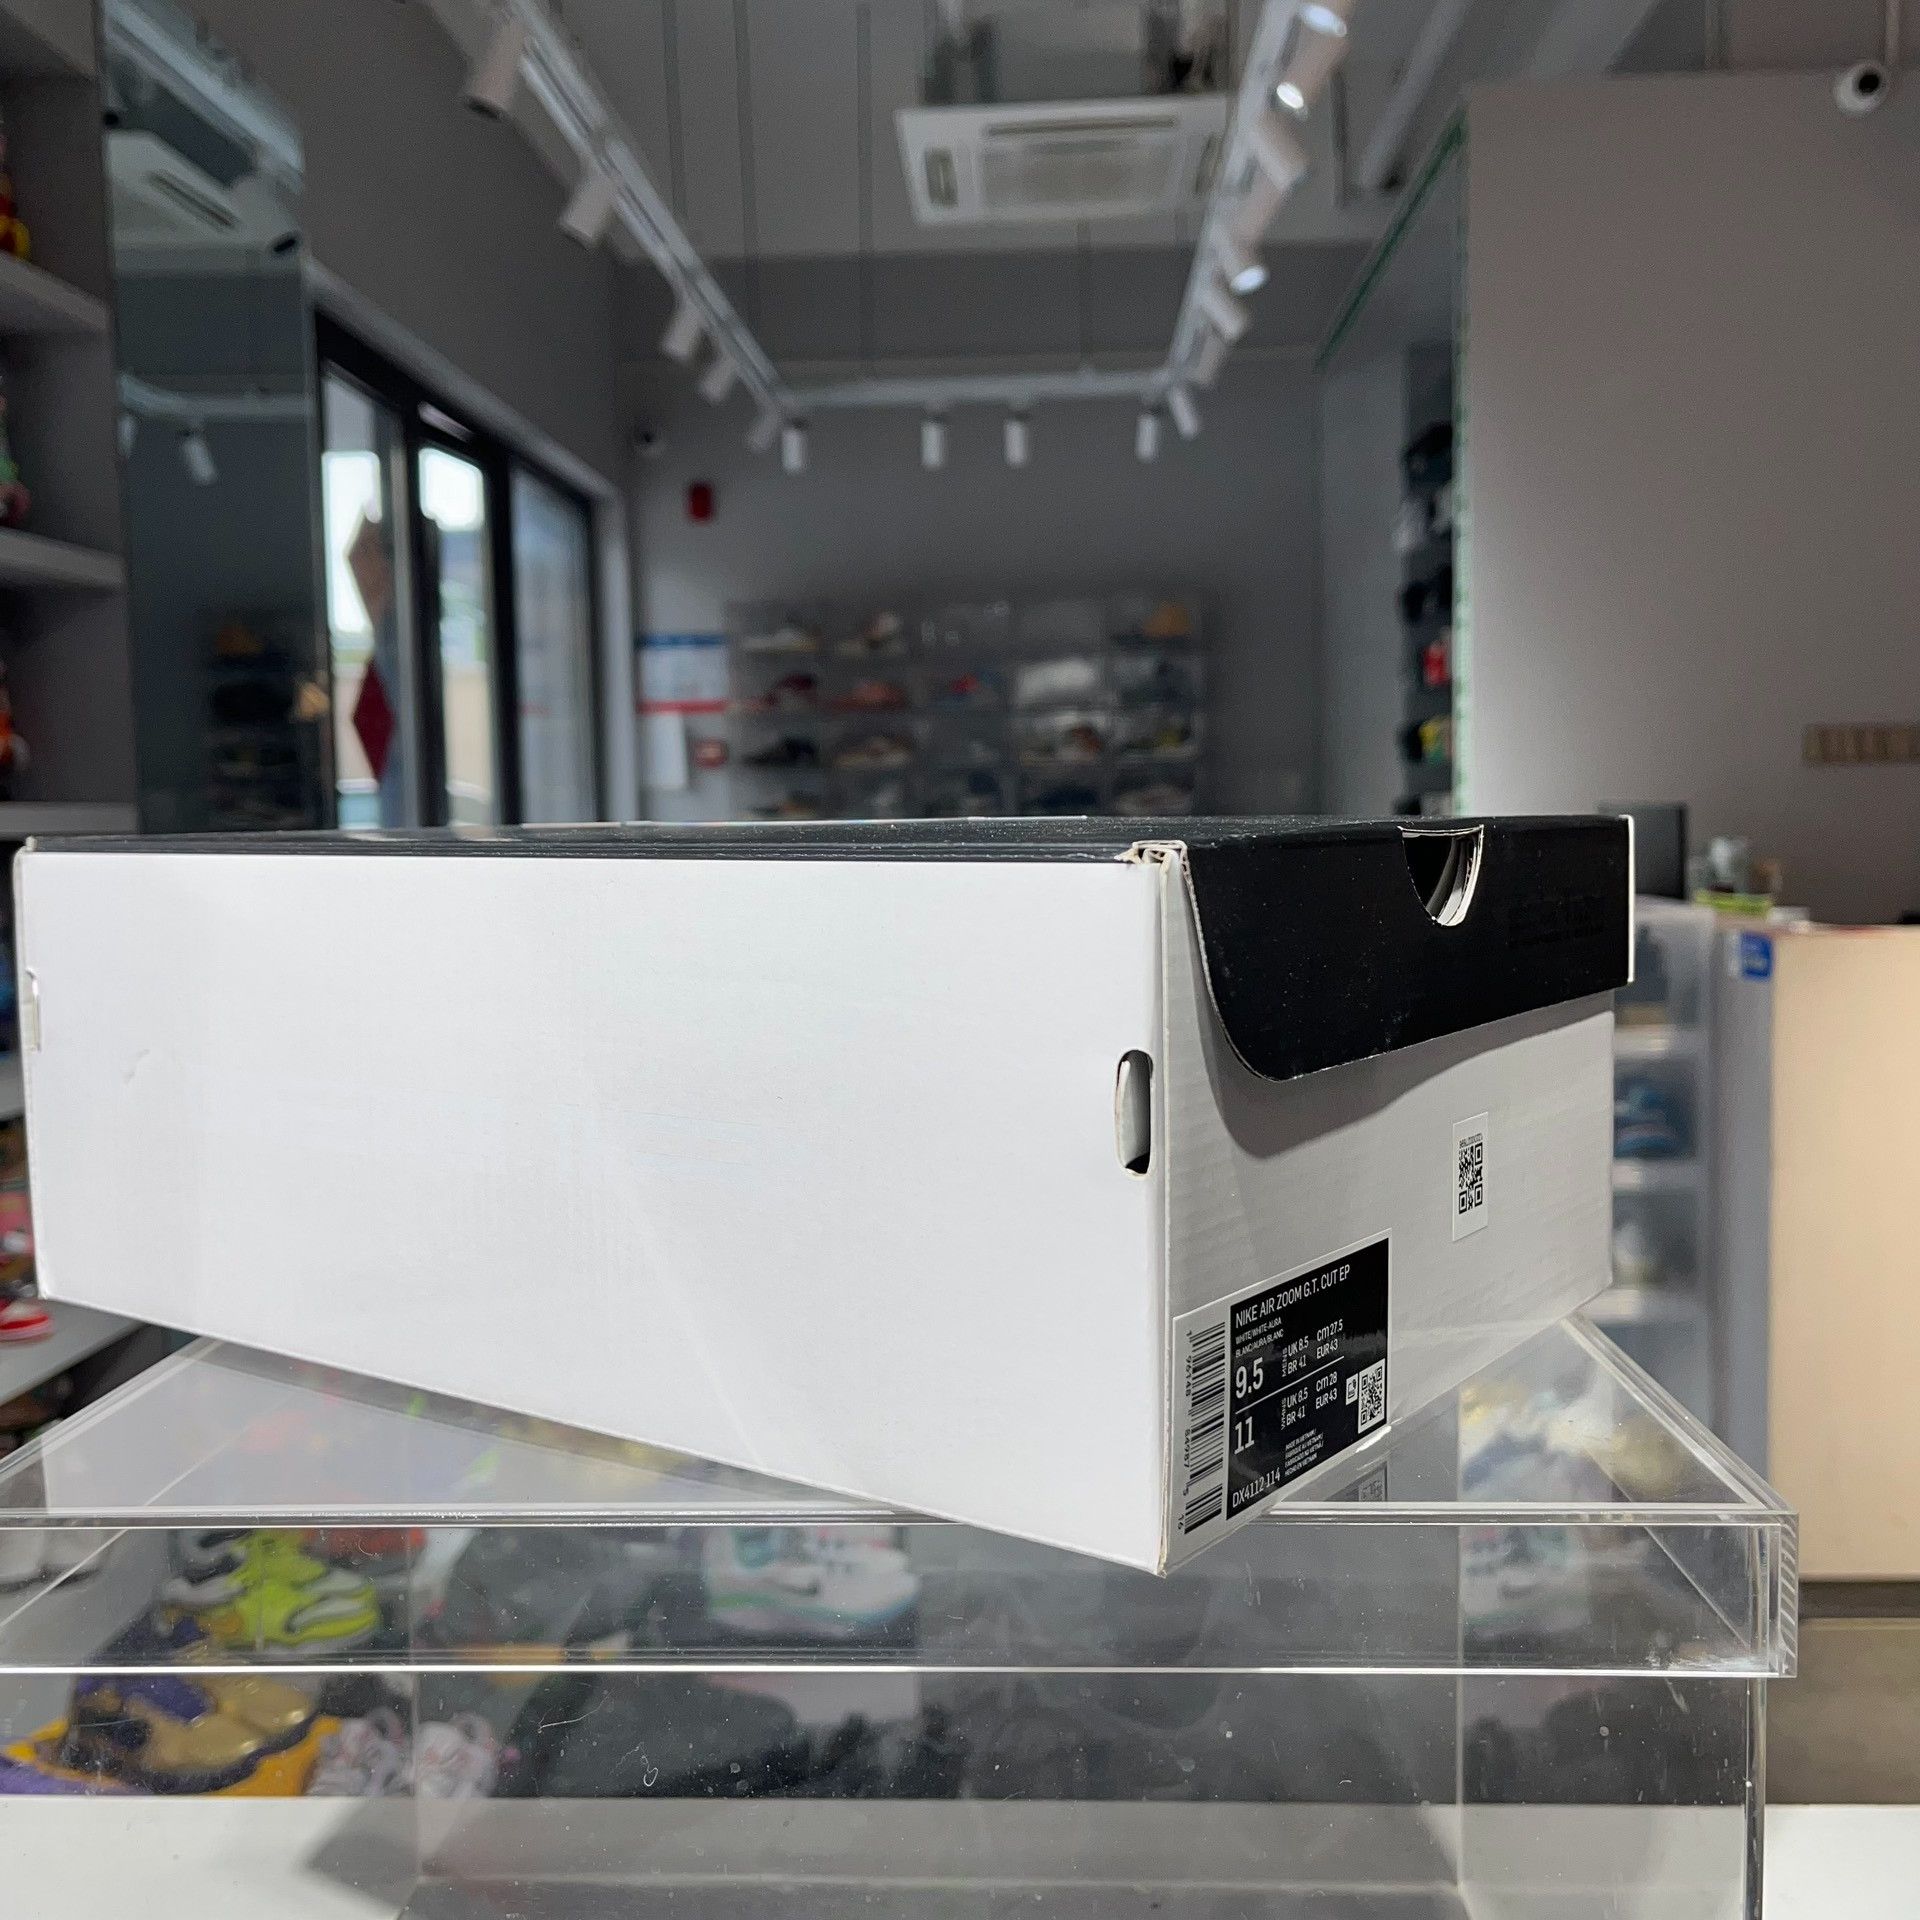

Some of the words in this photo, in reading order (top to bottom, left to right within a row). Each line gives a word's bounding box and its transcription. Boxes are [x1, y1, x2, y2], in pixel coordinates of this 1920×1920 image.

[1236, 1305, 1257, 1328] NIKE
[1260, 1298, 1274, 1317] AIR
[1277, 1286, 1302, 1310] ZOOM
[1304, 1278, 1319, 1297] G.T.
[1321, 1269, 1338, 1289] CUT
[1340, 1264, 1350, 1281] EP
[1331, 1319, 1343, 1335] 27.5
[1288, 1342, 1298, 1356] UK
[1299, 1336, 1309, 1351] 8.5
[1317, 1344, 1329, 1359] EUR
[1329, 1339, 1338, 1352] 43
[1288, 1360, 1297, 1374] BR
[1299, 1355, 1306, 1368] 41
[1236, 1358, 1263, 1398] 9.5
[1330, 1372, 1337, 1385] 28
[1288, 1394, 1297, 1408] UK
[1298, 1387, 1308, 1402] 8.5
[1316, 1393, 1328, 1409] EUR
[1329, 1388, 1337, 1401] 43
[1287, 1411, 1296, 1425] BR
[1298, 1406, 1305, 1418] 41
[1234, 1417, 1254, 1454] 11
[1233, 1468, 1280, 1507] DX4112-114
